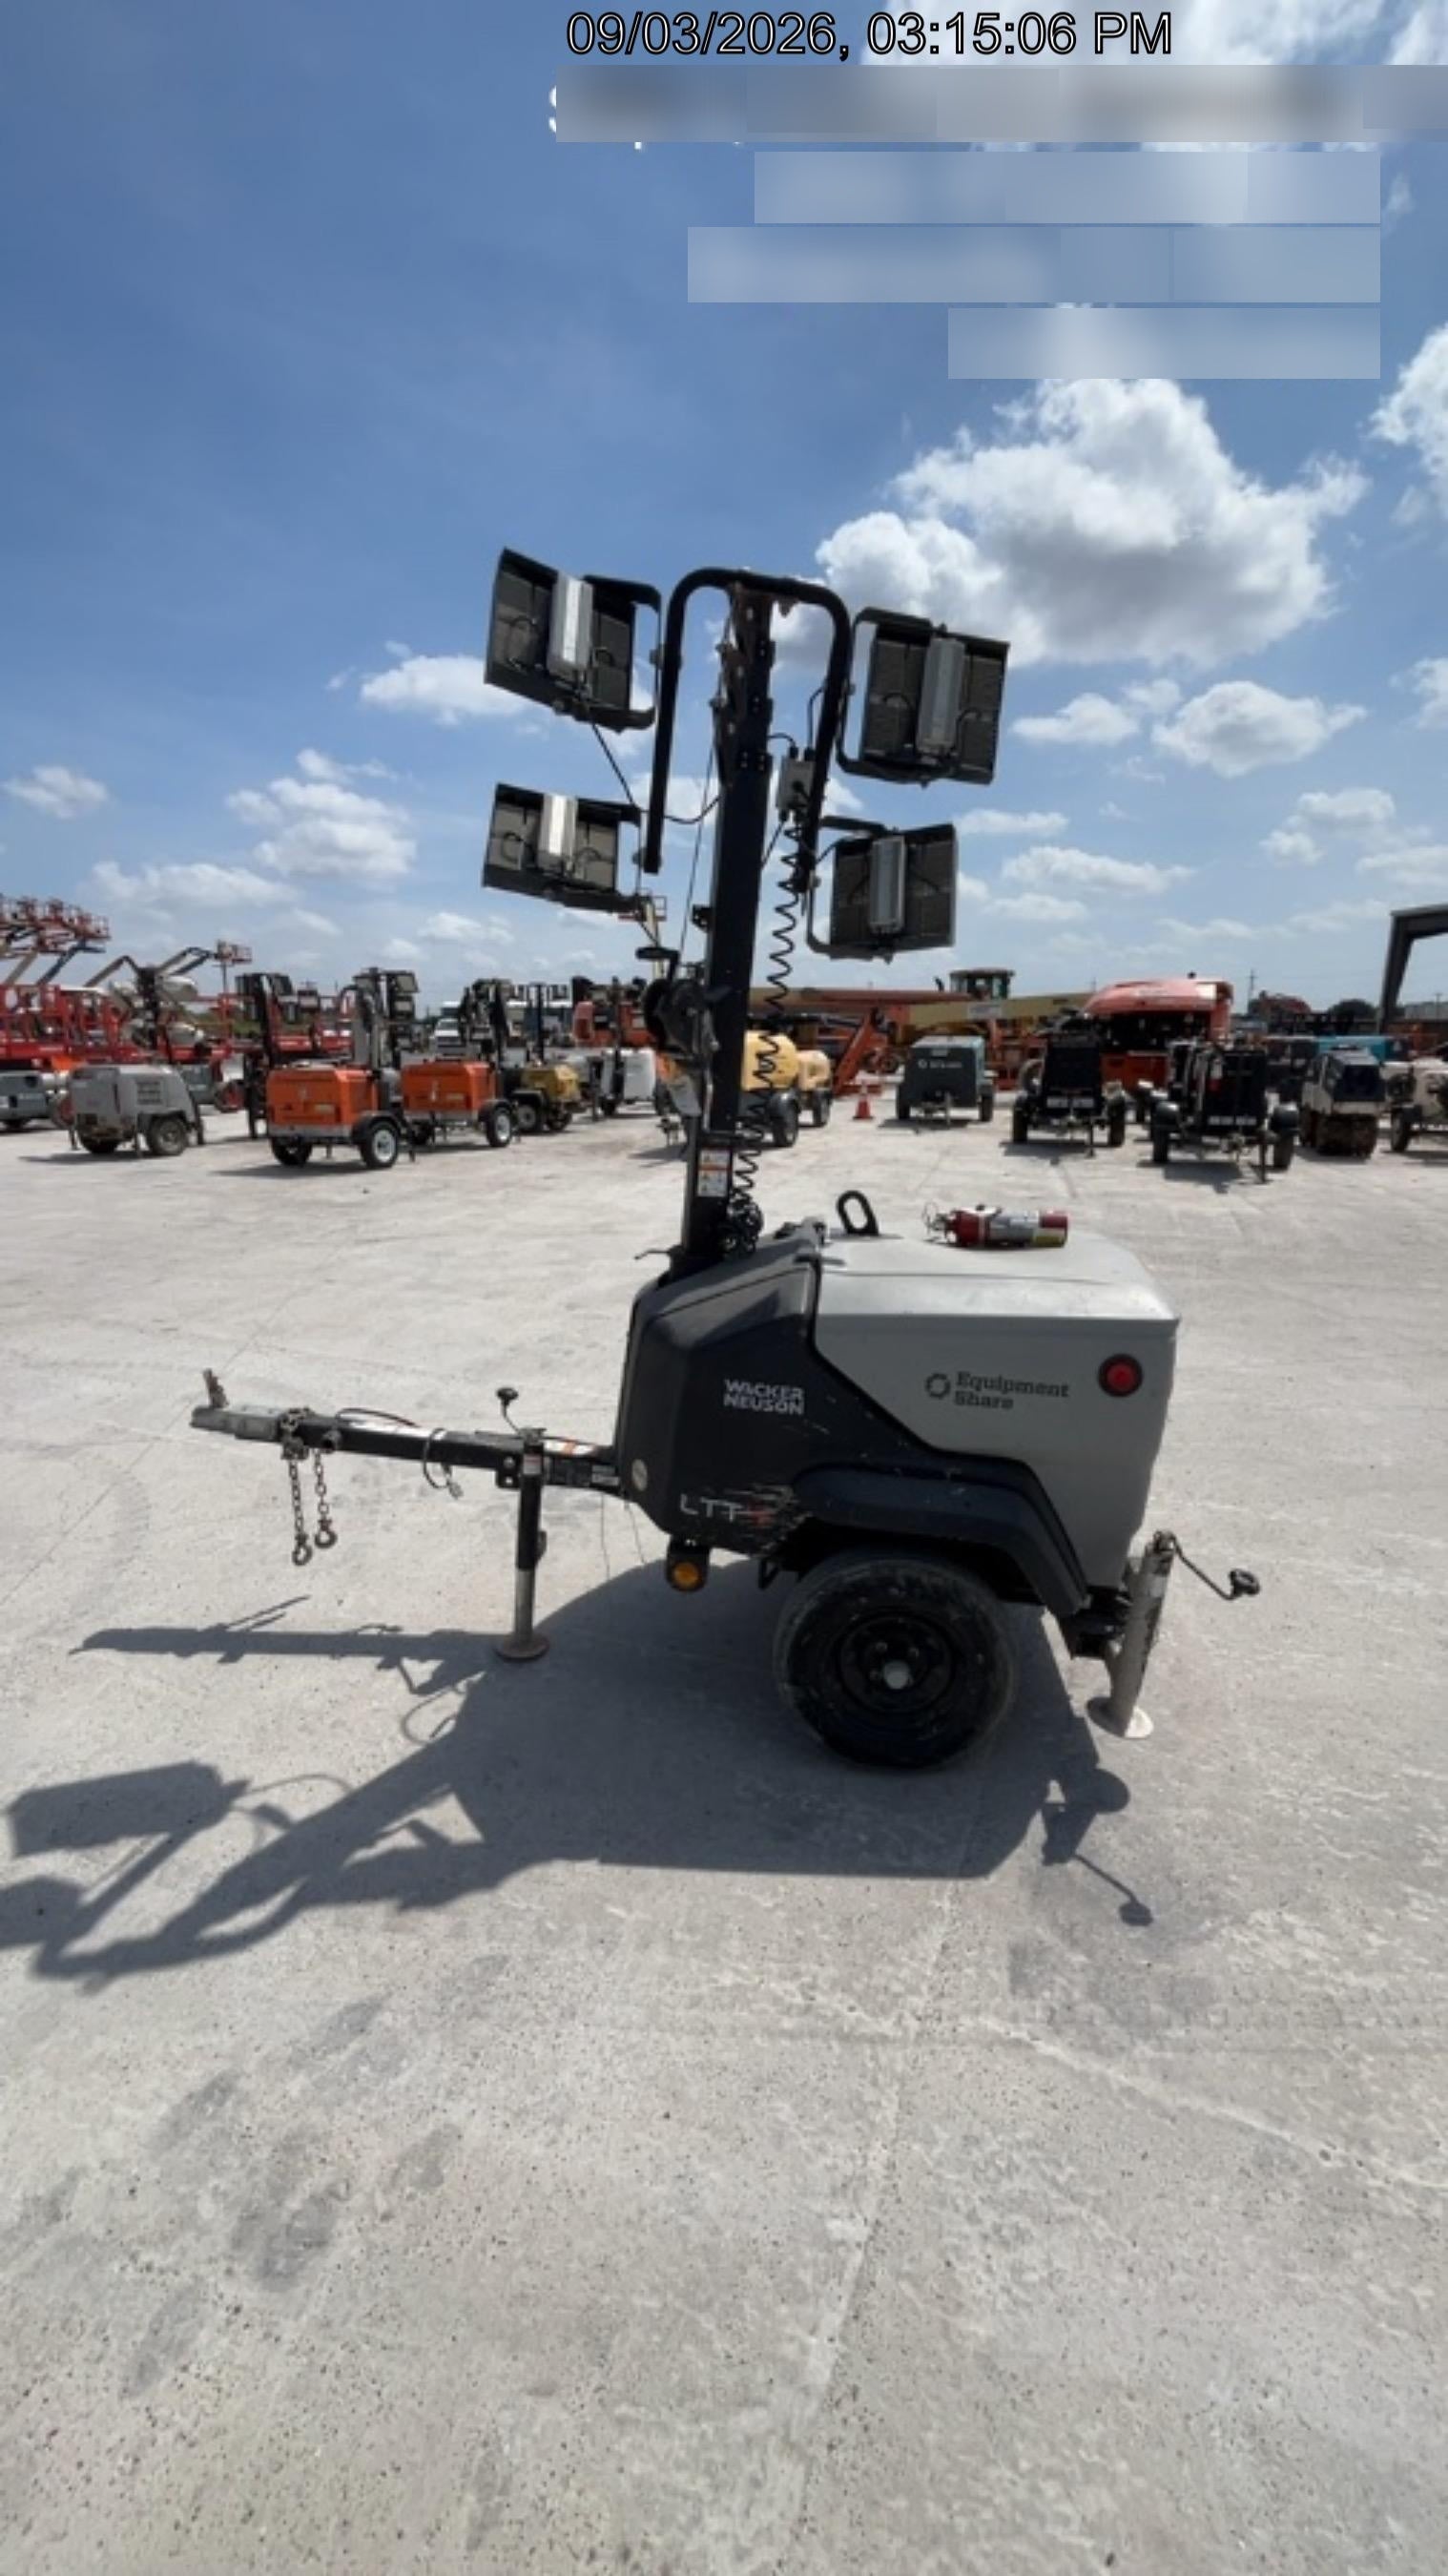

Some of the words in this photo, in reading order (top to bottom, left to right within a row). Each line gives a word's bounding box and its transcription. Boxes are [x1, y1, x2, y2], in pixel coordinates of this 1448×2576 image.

[724, 1379, 804, 1399] WACKER
[957, 1371, 1069, 1398] Equipment
[723, 1394, 804, 1415] NEUSON
[954, 1390, 1014, 1409] Share
